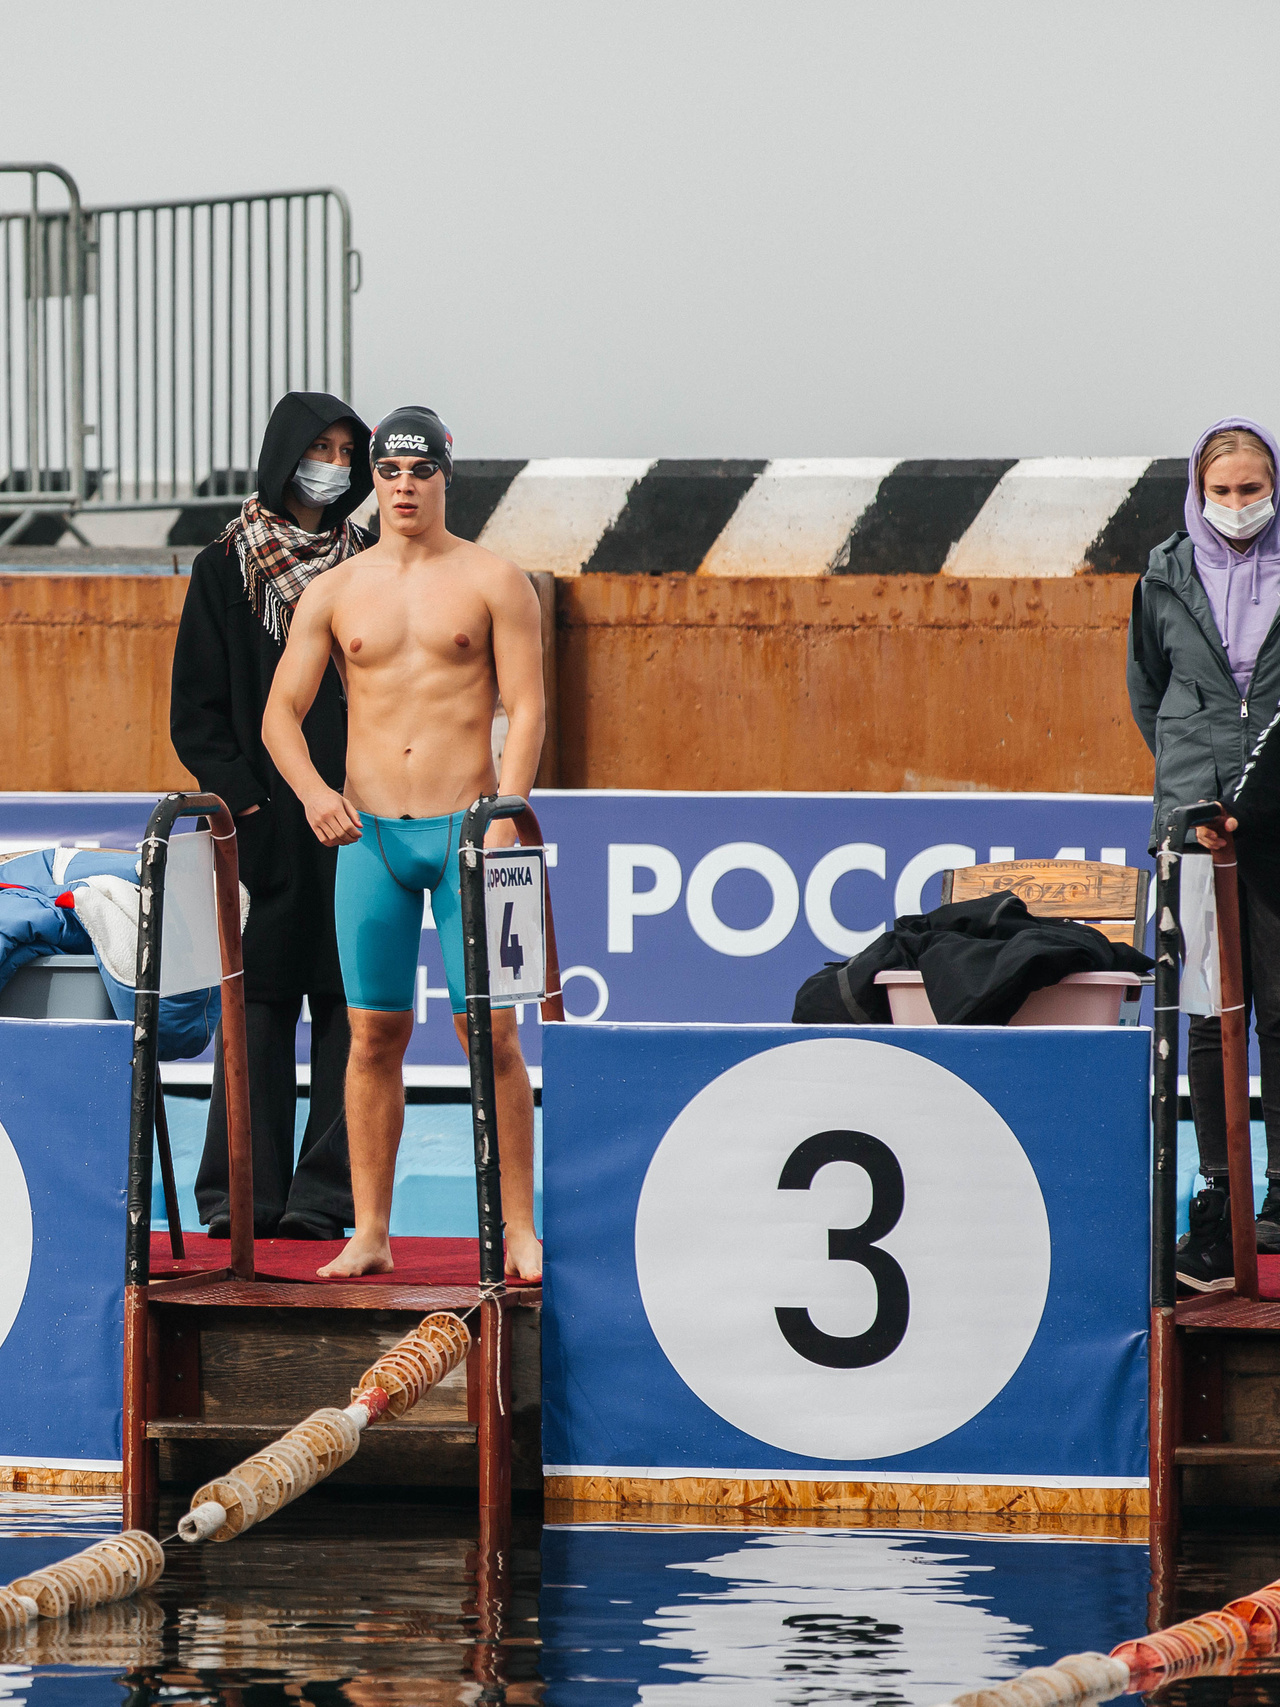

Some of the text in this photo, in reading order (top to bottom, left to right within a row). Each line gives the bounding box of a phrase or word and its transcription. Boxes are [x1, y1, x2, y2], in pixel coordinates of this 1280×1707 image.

[384, 441, 429, 452] WAVE
[388, 434, 425, 444] MAD
[499, 901, 524, 981] 4
[774, 1129, 911, 1370] 3
